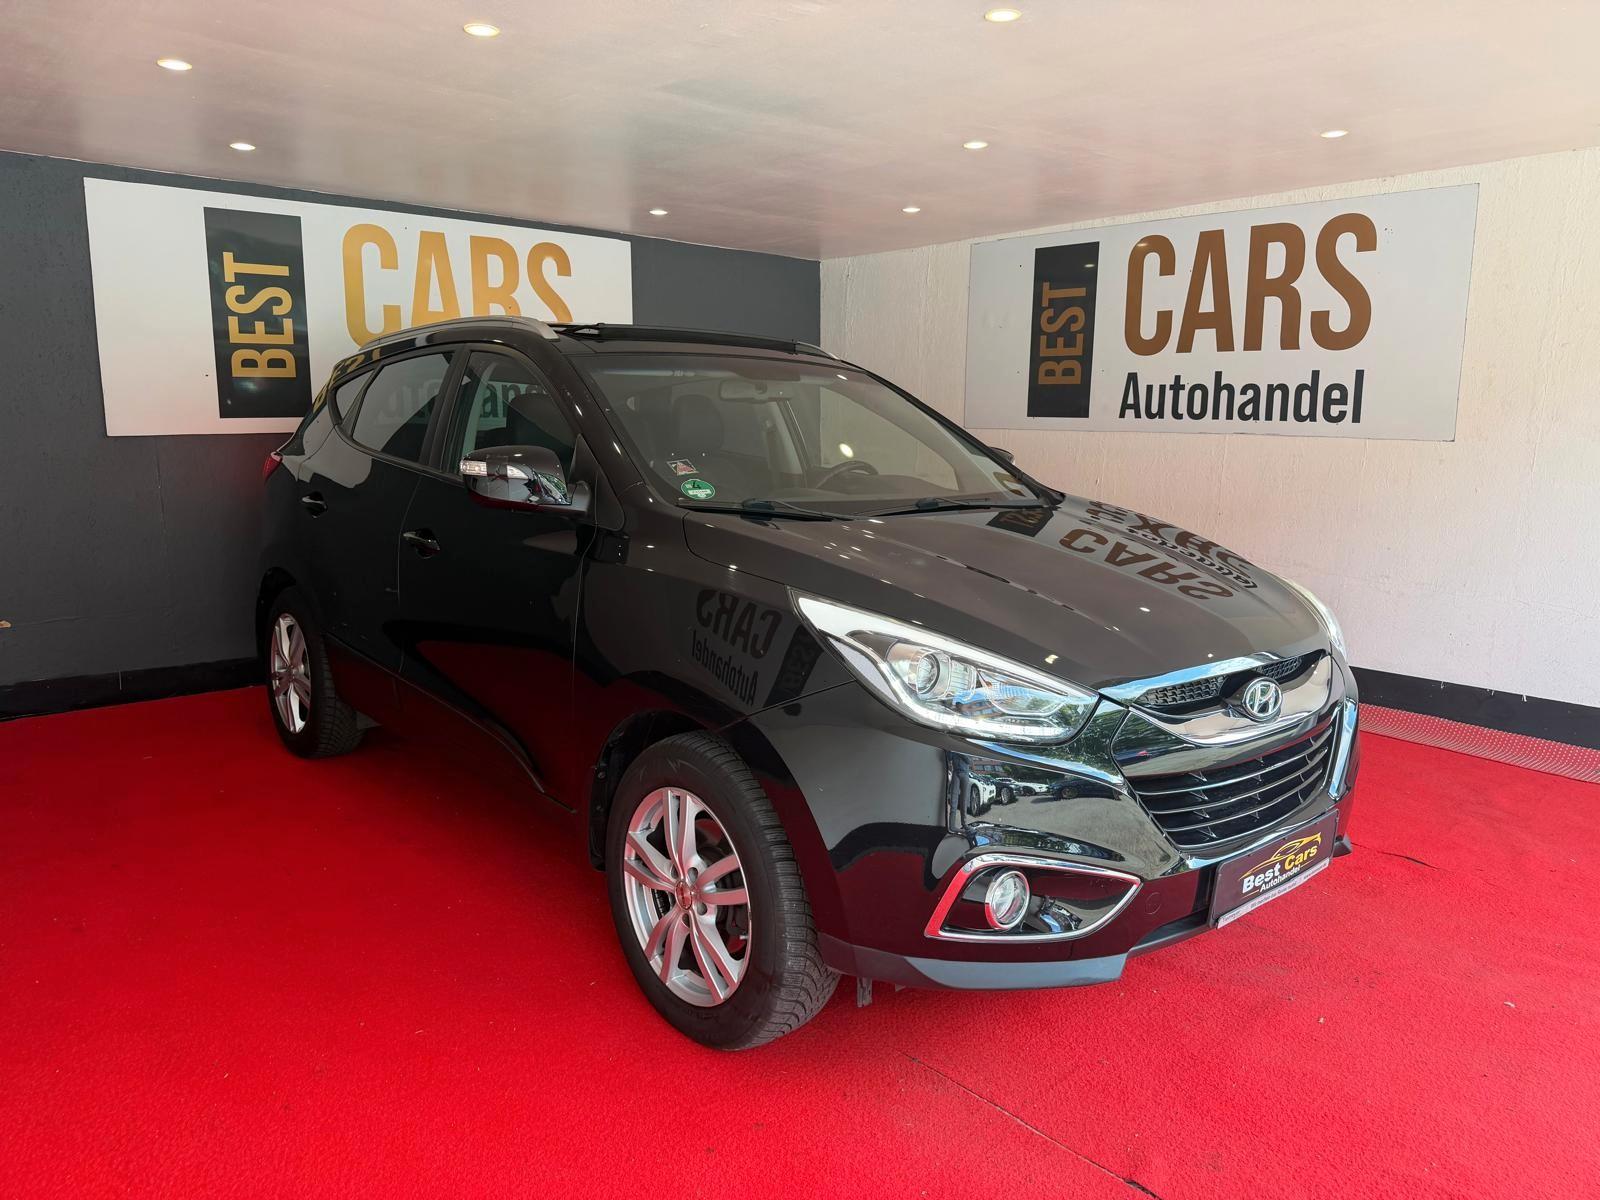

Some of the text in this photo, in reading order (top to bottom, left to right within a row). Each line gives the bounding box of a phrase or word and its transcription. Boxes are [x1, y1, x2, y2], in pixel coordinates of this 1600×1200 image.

[222, 251, 297, 379] BEST
[1124, 212, 1378, 356] CARS
[1038, 281, 1087, 385] BEST
[1119, 369, 1365, 424] Autohandel
[1242, 862, 1281, 894] Best
[1284, 845, 1318, 870] Cars
[1259, 865, 1301, 893] Autohandel
